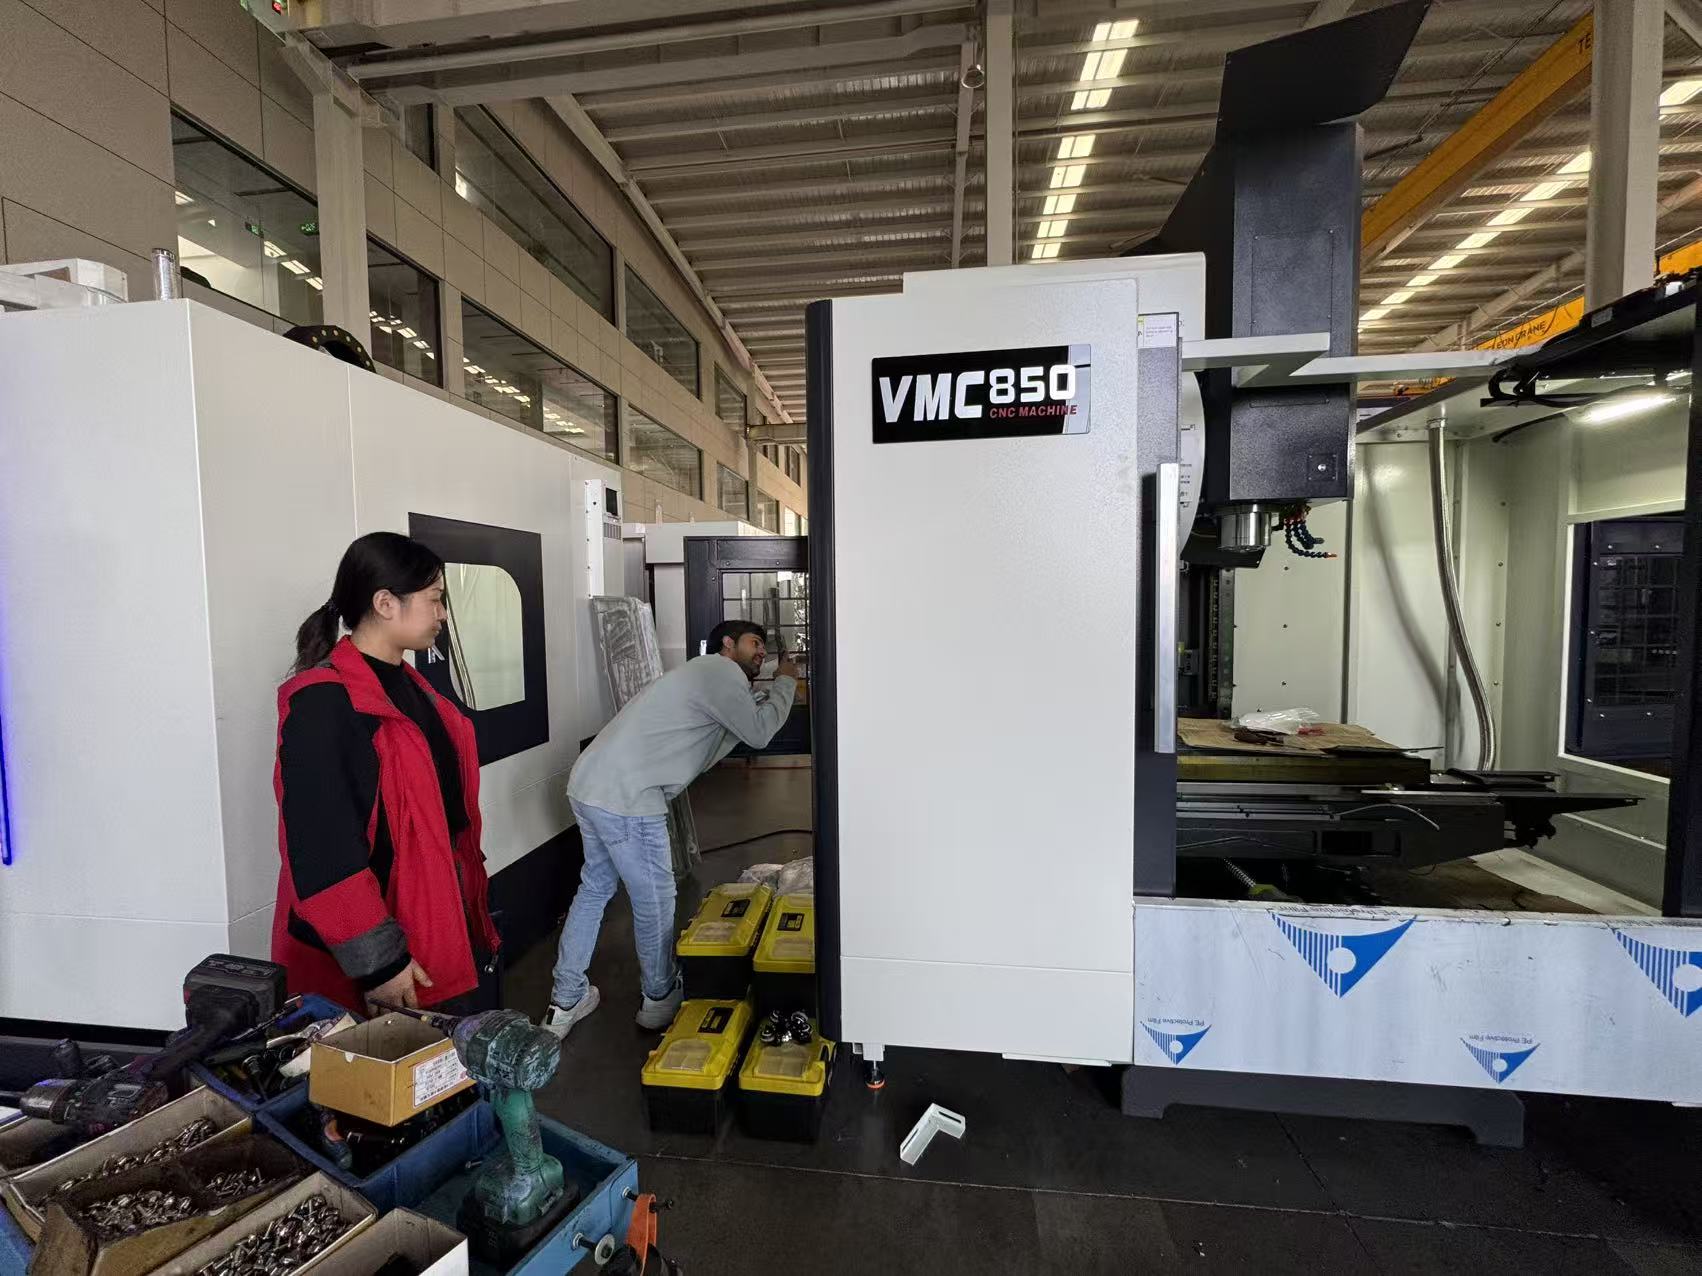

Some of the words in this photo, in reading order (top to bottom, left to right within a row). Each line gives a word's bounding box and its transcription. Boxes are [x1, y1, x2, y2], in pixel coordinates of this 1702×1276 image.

[990, 406, 1016, 419] CNC
[1018, 403, 1078, 418] MACHINE
[1147, 1017, 1162, 1025] Film
[1162, 1017, 1194, 1026] Protective
[1194, 1019, 1205, 1027] PE
[1484, 1035, 1520, 1044] Protective
[1521, 1037, 1533, 1045] PE
